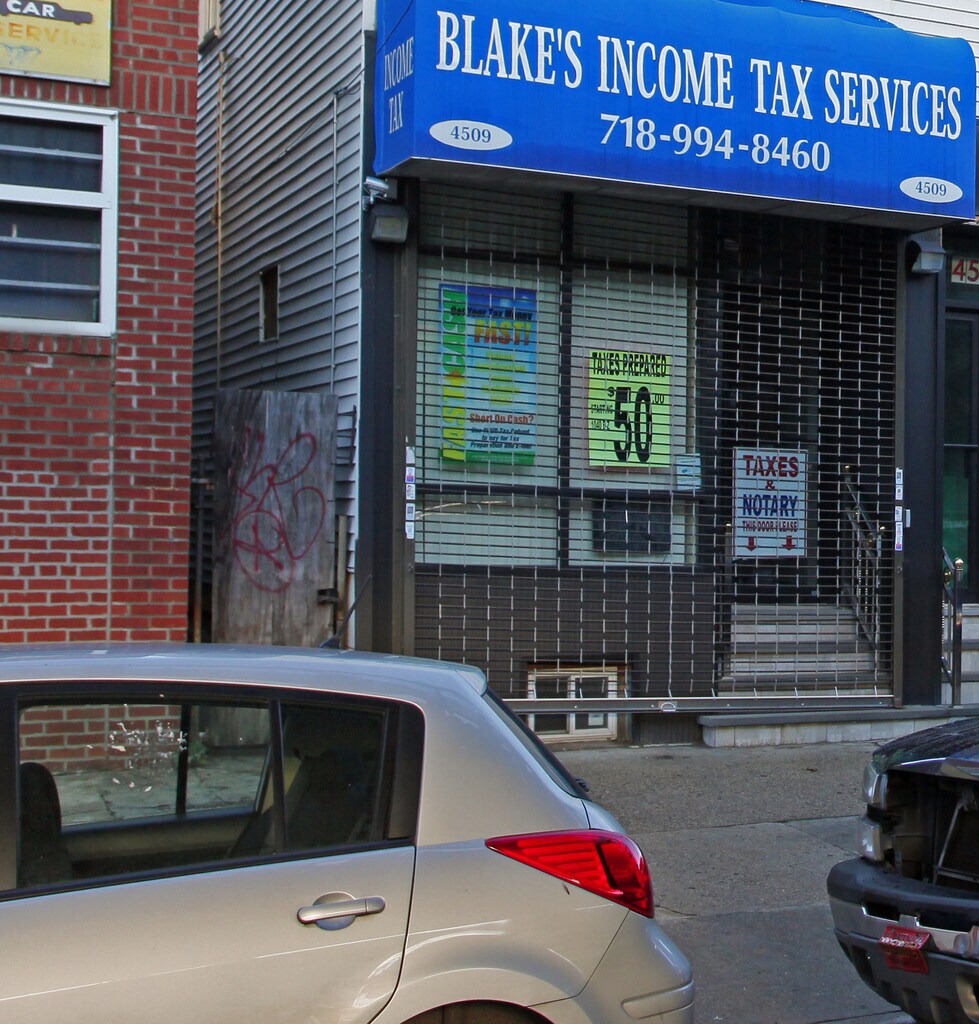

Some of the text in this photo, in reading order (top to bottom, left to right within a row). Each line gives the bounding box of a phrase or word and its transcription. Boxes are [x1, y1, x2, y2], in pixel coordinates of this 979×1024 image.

[384, 36, 414, 91] INCOME
[436, 10, 962, 140] BLAKE'S INCOME TAX SERVICES
[389, 91, 404, 134] TAX
[450, 126, 492, 144] 4509
[600, 113, 831, 172] 718-994-8460
[915, 181, 948, 198] 4509
[474, 319, 532, 346] FAST!
[592, 351, 667, 378] TAXES PREPARED
[742, 454, 800, 478] TAXES
[765, 479, 776, 490] &
[742, 493, 799, 517] NOTARY
[742, 520, 756, 532] THIS
[757, 520, 774, 532] DOOR
